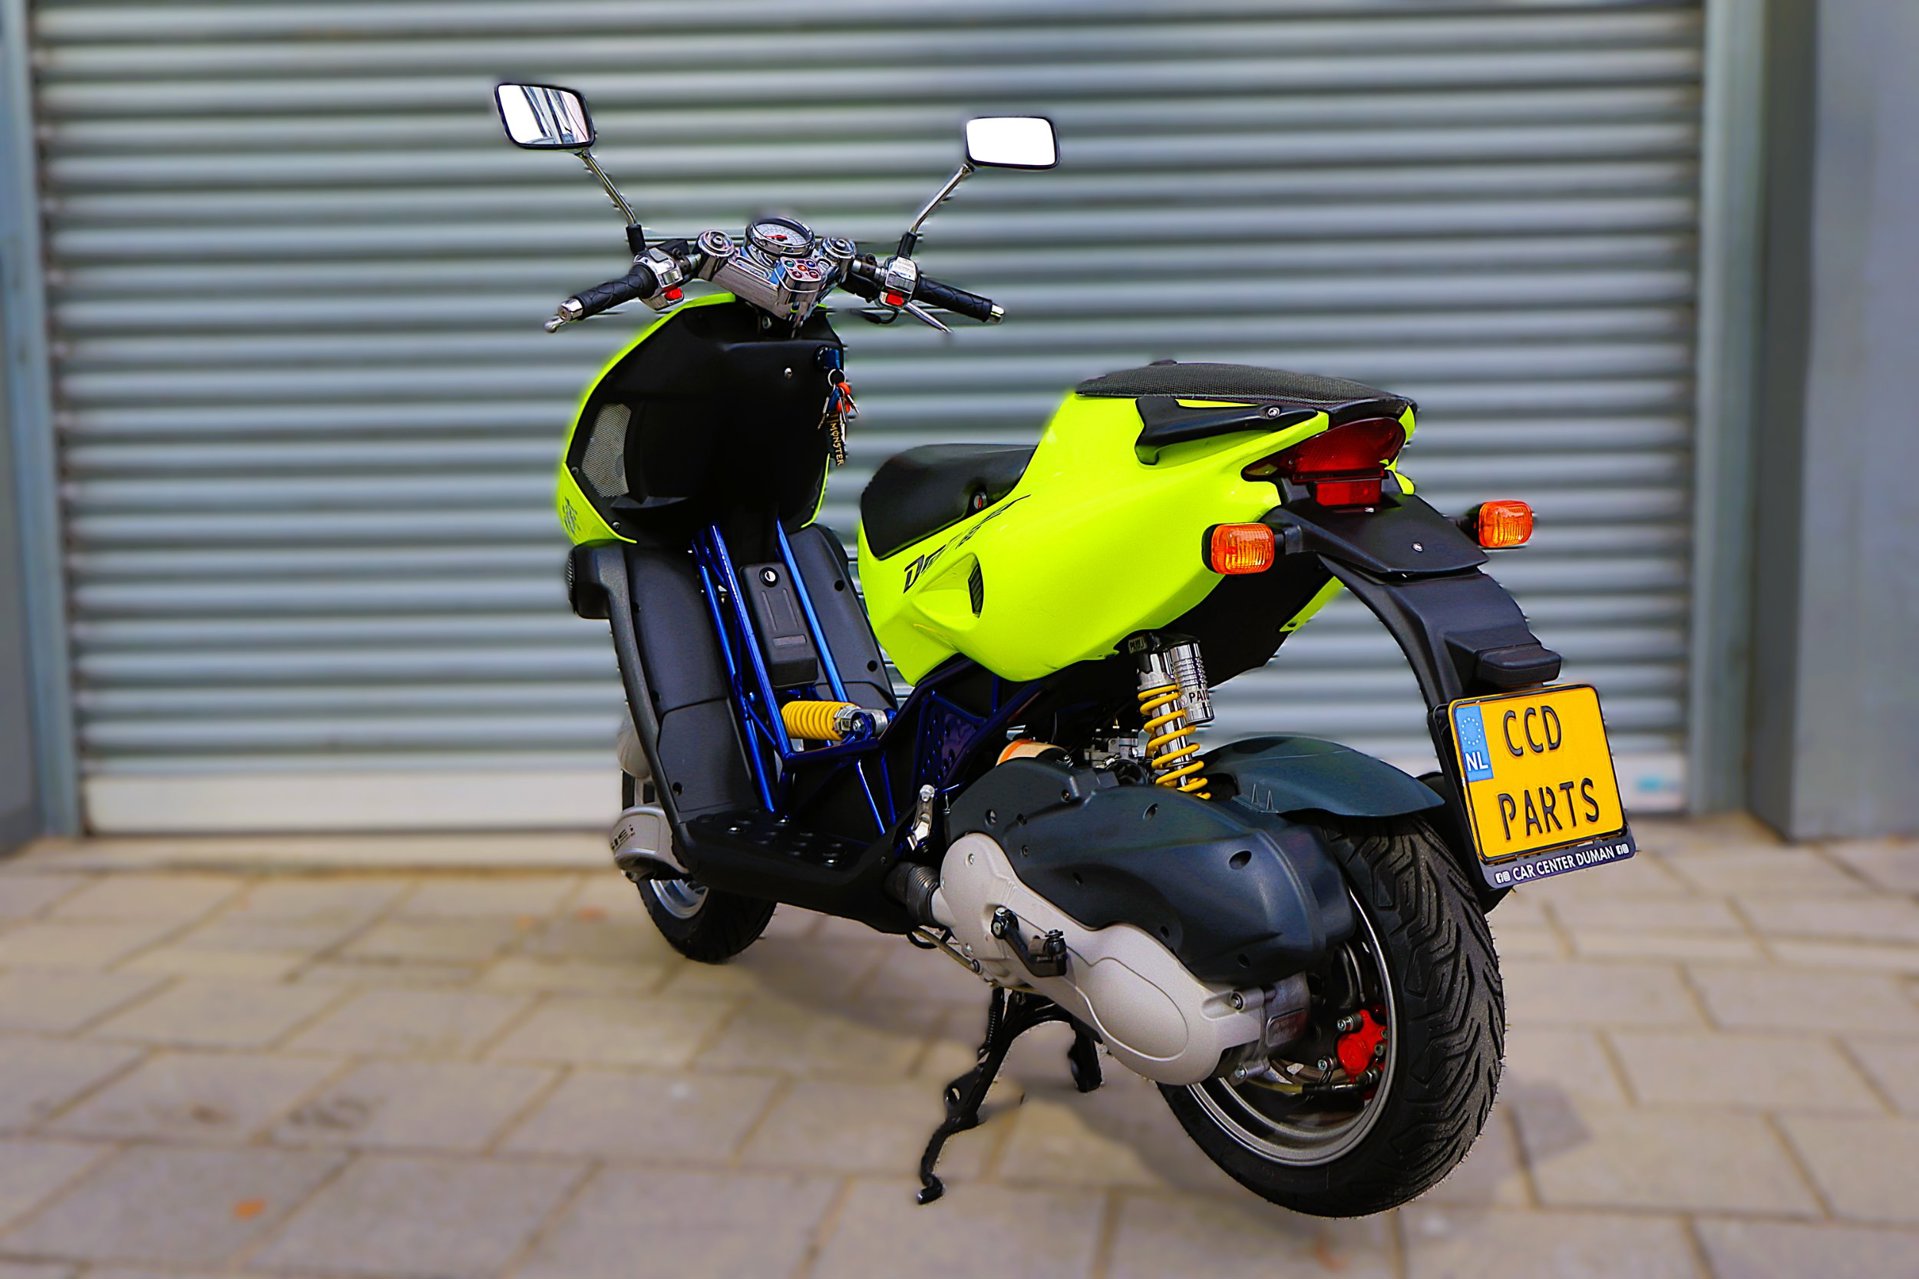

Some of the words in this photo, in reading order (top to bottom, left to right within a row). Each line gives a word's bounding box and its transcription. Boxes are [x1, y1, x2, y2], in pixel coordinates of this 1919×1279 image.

[1502, 705, 1562, 757] CCD
[1465, 751, 1489, 771] NL
[1497, 777, 1600, 840] PARTS
[1512, 864, 1536, 881] CAR
[1536, 858, 1576, 875] CENTER
[1576, 846, 1615, 866] DUMAN
